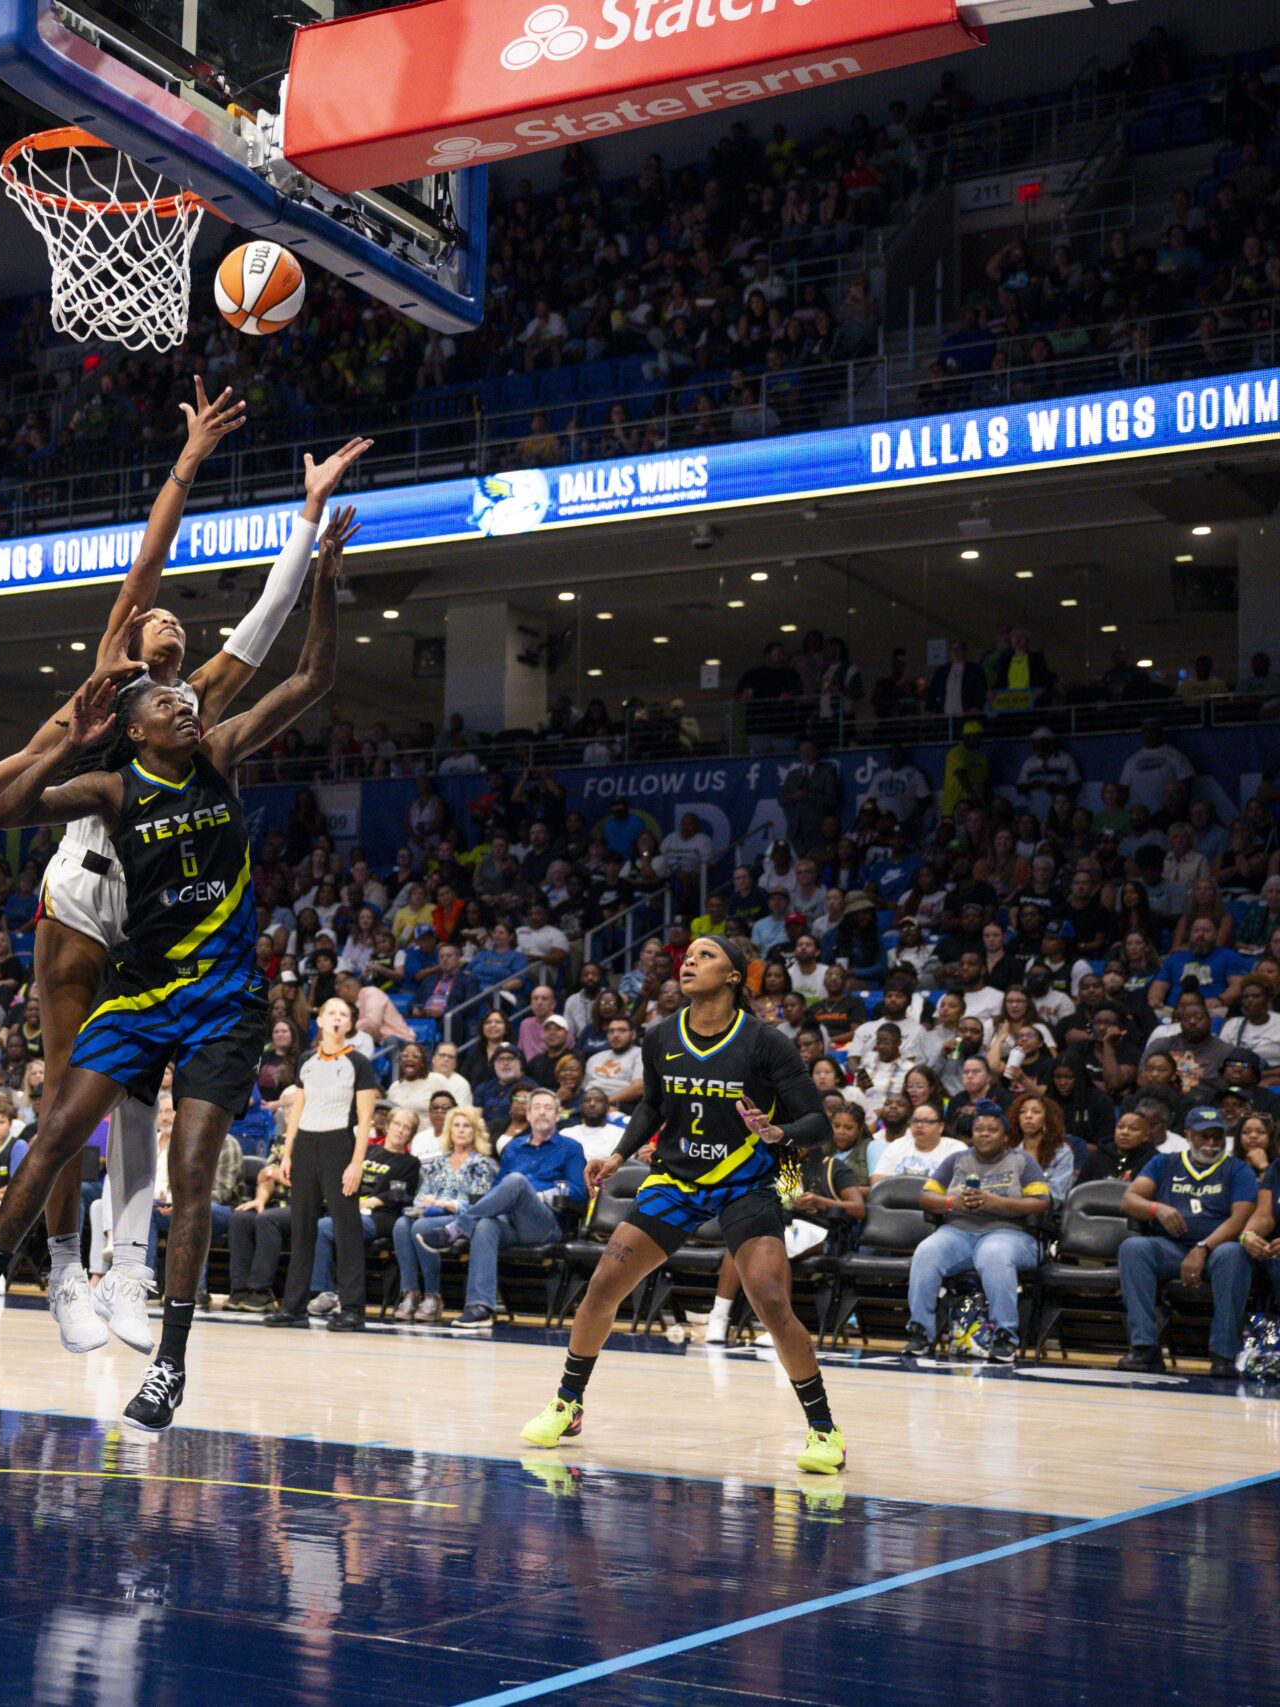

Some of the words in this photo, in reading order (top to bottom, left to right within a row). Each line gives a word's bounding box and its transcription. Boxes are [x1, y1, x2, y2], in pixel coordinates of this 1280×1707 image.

[871, 415, 1009, 474] DALLAS
[1027, 396, 1156, 452] WINGS
[558, 465, 635, 504] DALLAS
[637, 456, 708, 495] WINGS
[53, 529, 179, 575] COMMUN
[190, 506, 330, 559] FOUNDAT
[583, 772, 688, 799] FOLLOW
[693, 769, 727, 792] US
[135, 803, 232, 844] TEXAS
[178, 879, 227, 904] GEM
[663, 1075, 745, 1099] TEXAS
[690, 1102, 704, 1136] 2
[688, 1142, 728, 1160] GEM
[1171, 1183, 1223, 1197] DALLAS
